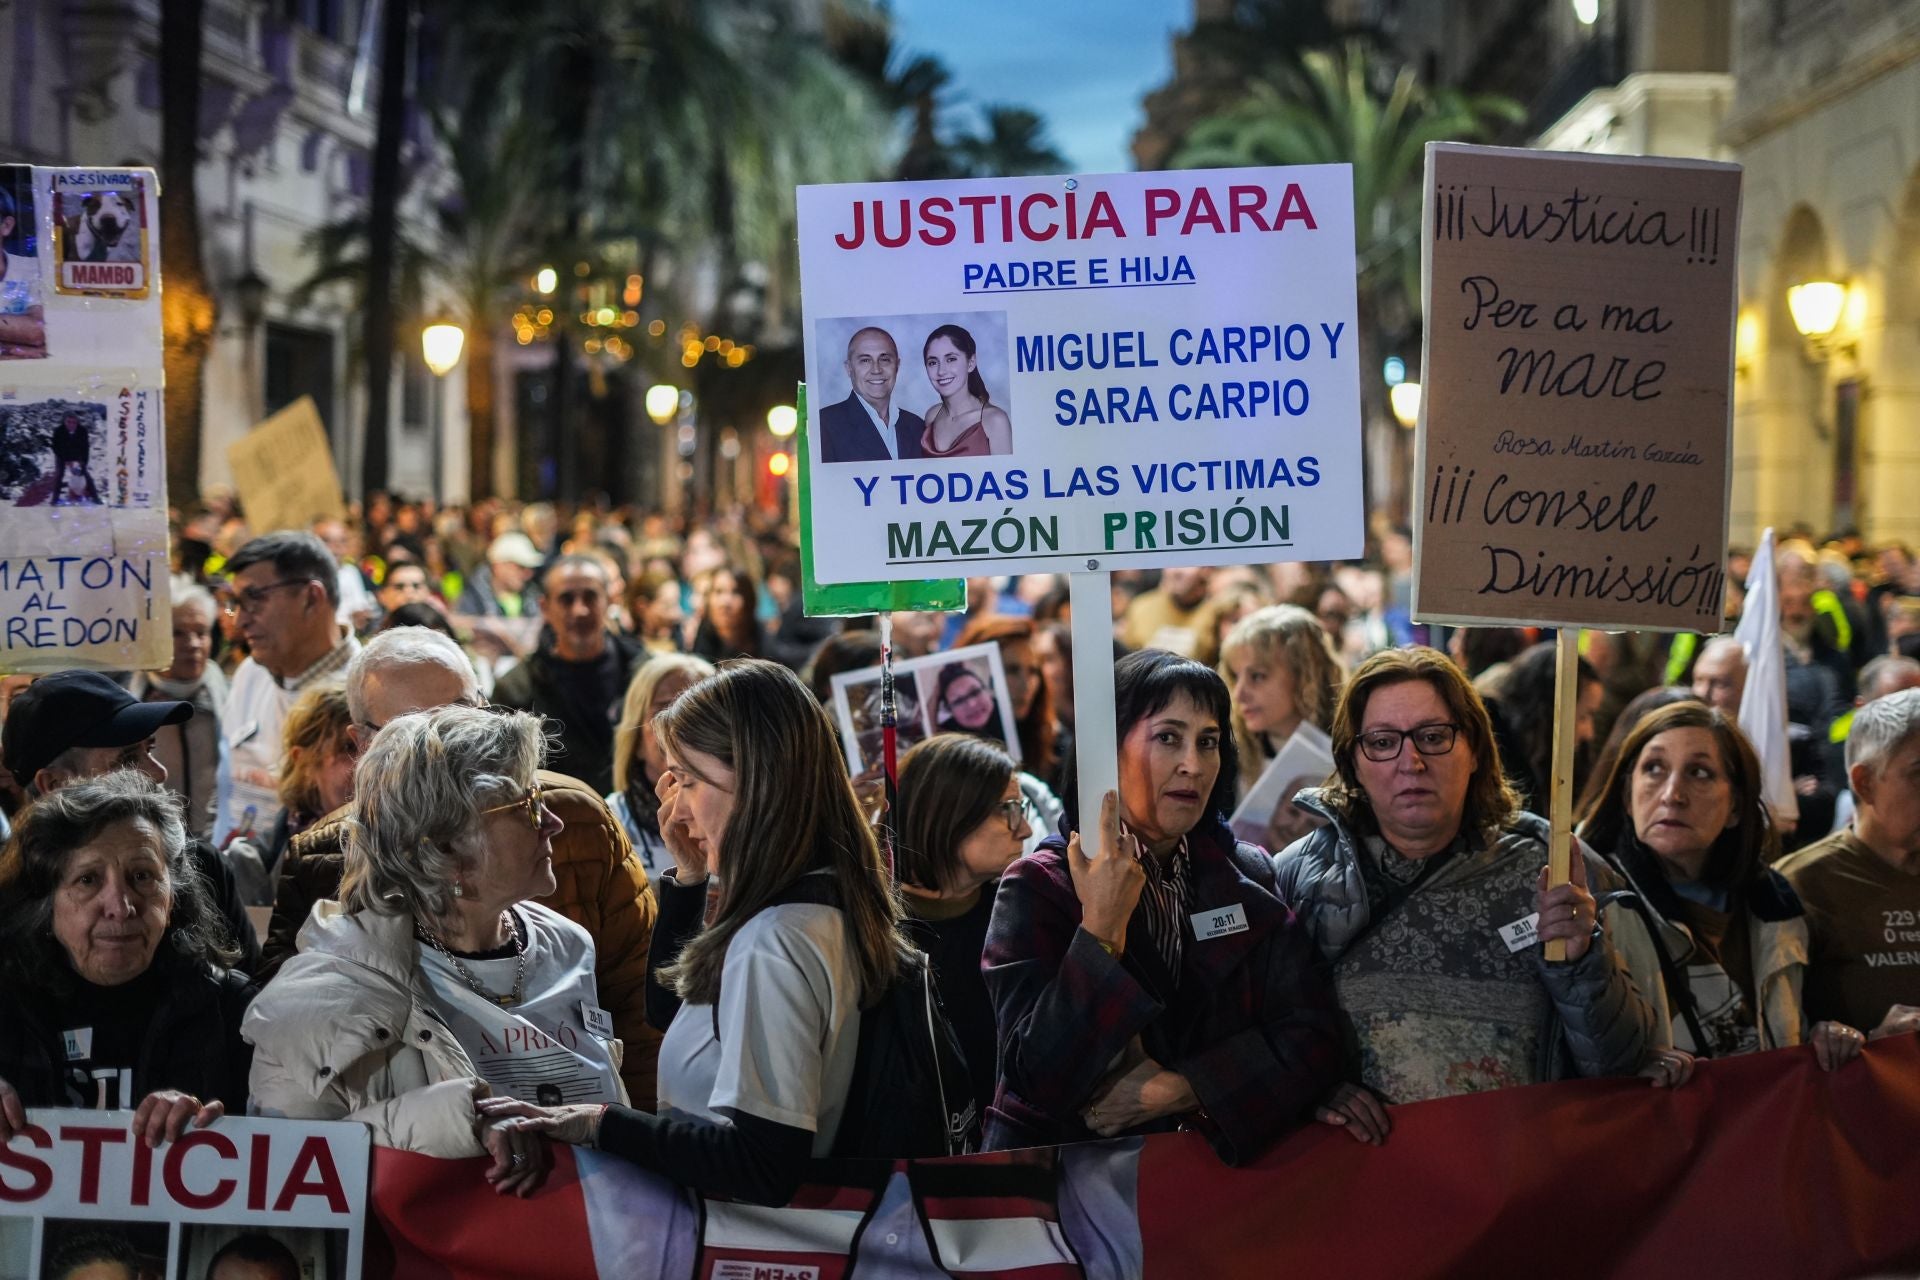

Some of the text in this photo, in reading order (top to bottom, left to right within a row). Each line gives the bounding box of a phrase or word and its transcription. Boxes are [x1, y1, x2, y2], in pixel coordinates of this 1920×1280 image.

[835, 183, 1318, 250] JUSTICIA PARA
[71, 264, 135, 285] MAMBO
[964, 255, 1196, 290] PADRE E HIJA
[1460, 275, 1673, 334] Per a ma
[1016, 322, 1345, 373] MIGUEL CARPIO Y
[1055, 378, 1310, 427] SARA CARPIO
[1493, 429, 1555, 457] Rosa
[853, 456, 1321, 507] Y TODAS LAS VICTIMAS
[887, 496, 1291, 559] MAZÓN PRISIÓN
[22, 591, 67, 613] AL
[0, 608, 138, 650] REDÓN
[1212, 913, 1236, 929] 20:11
[1881, 910, 1916, 927] 229
